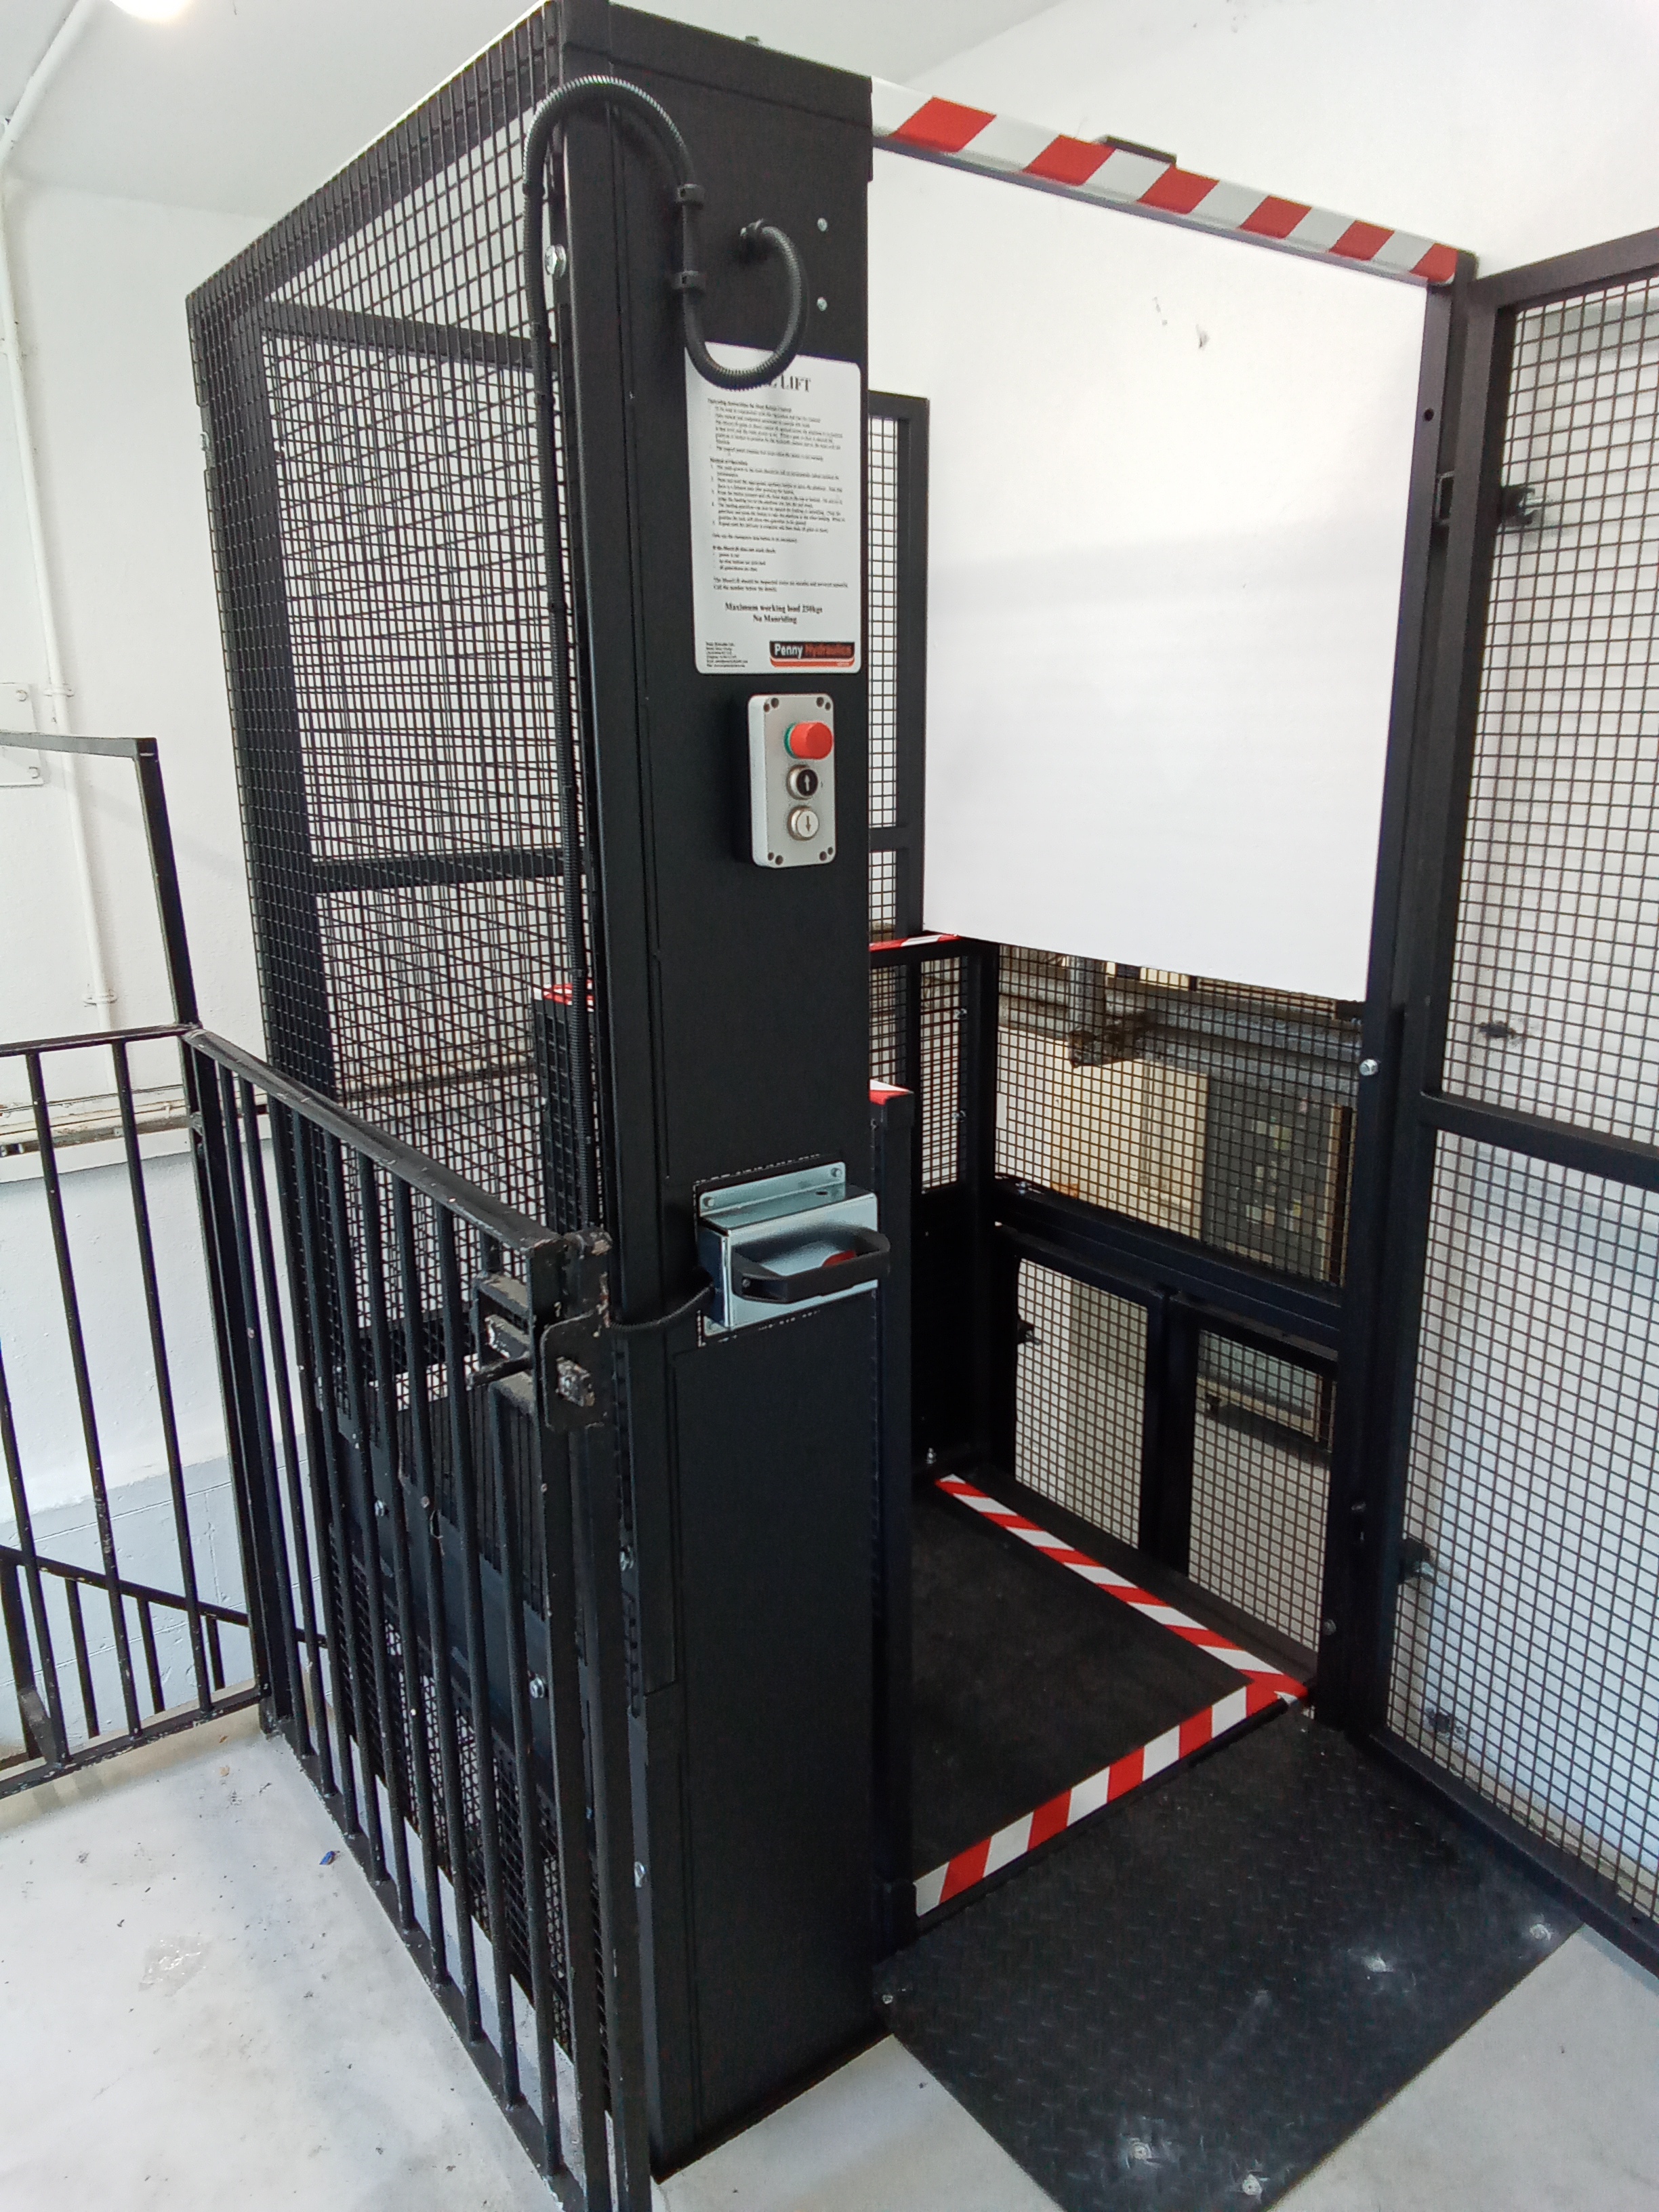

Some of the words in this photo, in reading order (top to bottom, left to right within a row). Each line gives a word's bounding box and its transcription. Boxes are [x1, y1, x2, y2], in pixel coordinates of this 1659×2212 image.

[781, 374, 811, 392] LIFT
[725, 602, 758, 612] Maximum
[760, 604, 785, 613] working
[787, 604, 800, 613] load
[774, 643, 803, 659] Penny
